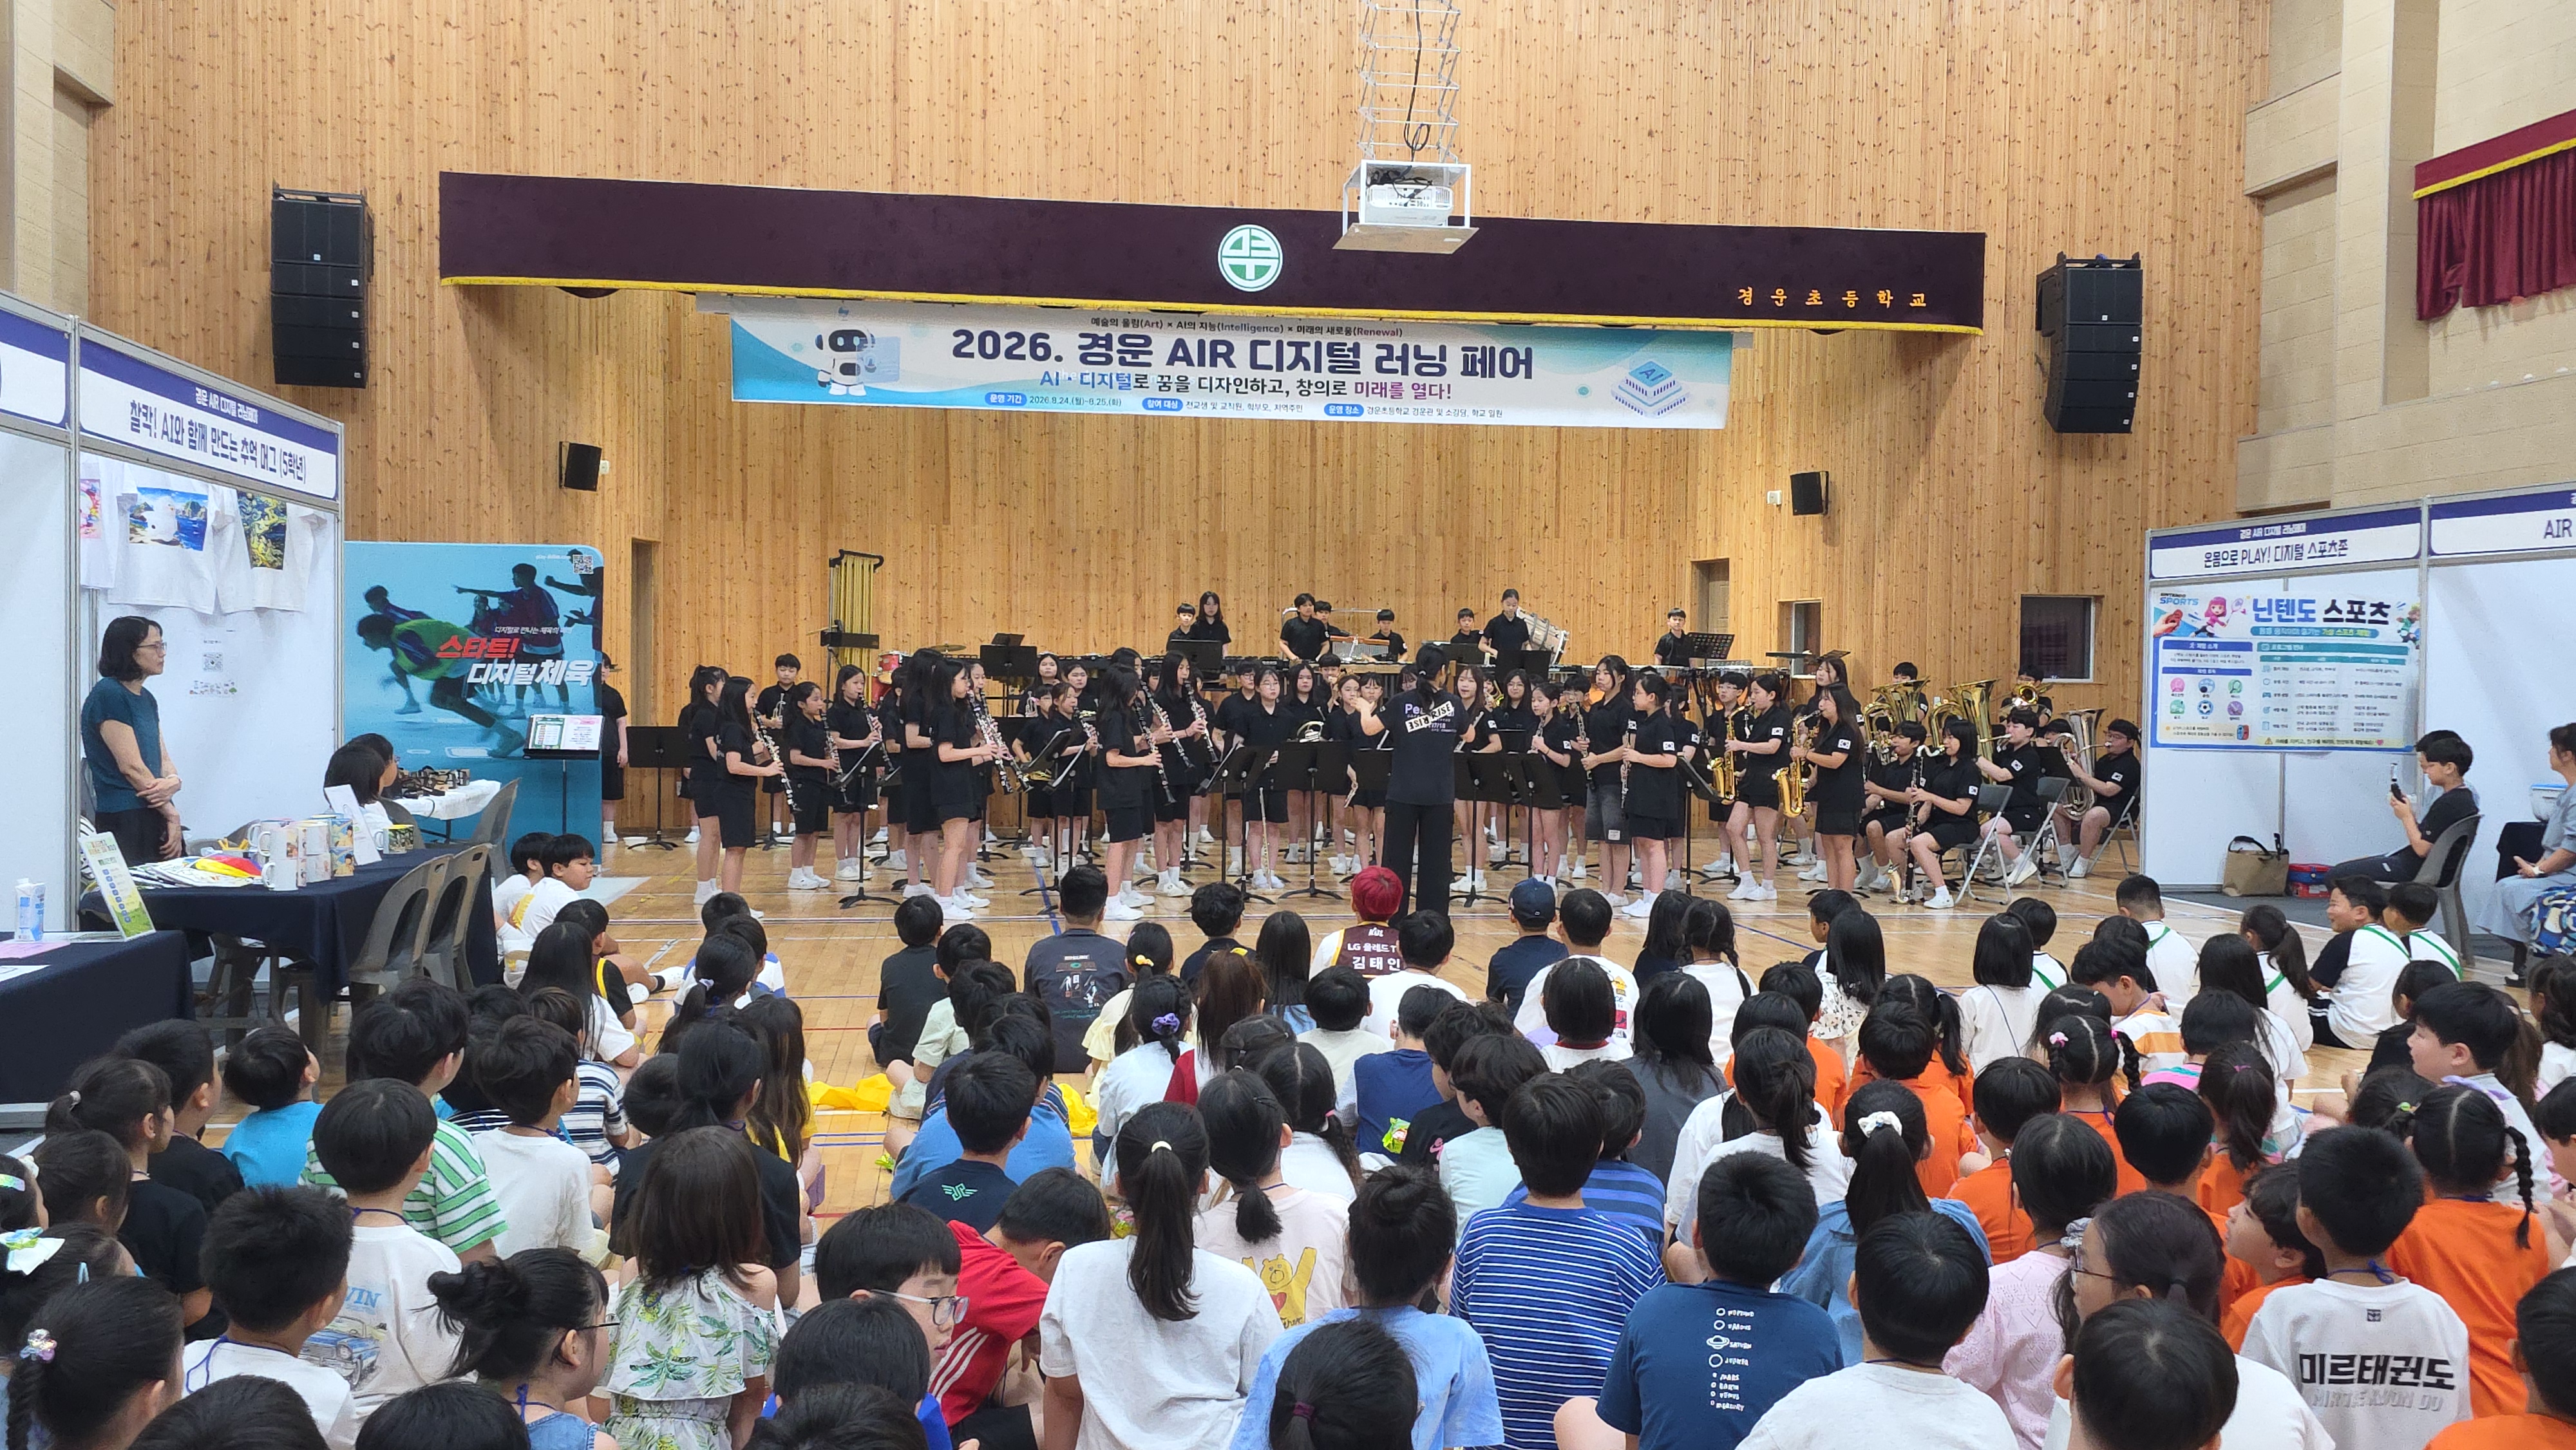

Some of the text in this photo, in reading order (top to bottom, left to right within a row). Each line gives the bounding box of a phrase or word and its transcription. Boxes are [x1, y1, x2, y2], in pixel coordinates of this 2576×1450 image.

[1091, 317, 1118, 327] 예술의
[1177, 321, 1196, 330] AI의
[1199, 321, 1283, 334] 지능(Intelligence)
[1296, 325, 1323, 335] 미래의
[952, 329, 1533, 379] 2026. 경운 AIR 디지털 러닝 페어
[1640, 368, 1664, 382] AI
[1039, 371, 1059, 386] AI
[1080, 372, 1150, 390] 디지털로
[1157, 375, 1190, 393] 꿈을
[1198, 376, 1290, 398] 디자인하고,
[1296, 379, 1347, 397] 창의로
[1354, 381, 1405, 399] 미래를
[1411, 382, 1451, 400] 열다!
[209, 391, 220, 411] AIR
[1007, 395, 1023, 404] 기간
[1186, 400, 1208, 410] 전교생
[1211, 402, 1218, 411] 및
[1274, 404, 1303, 413] 지역주민
[1436, 407, 1443, 417] 및
[130, 399, 307, 485] 찰칵! AI와 함께 만드는 추억 머그 (5학년)
[2543, 518, 2573, 539] AIR
[2204, 539, 2349, 569] 온몸으로 PLAY! 디지털 스포츠존
[2159, 597, 2199, 606] SPORTS
[2253, 598, 2391, 625] 닌텐도 스포츠
[435, 635, 520, 659] 스타트!
[1430, 702, 1451, 719] RISE
[1347, 943, 1361, 951] LG
[1363, 943, 1390, 952] 올레드
[2299, 1353, 2456, 1390] 미르태권도
